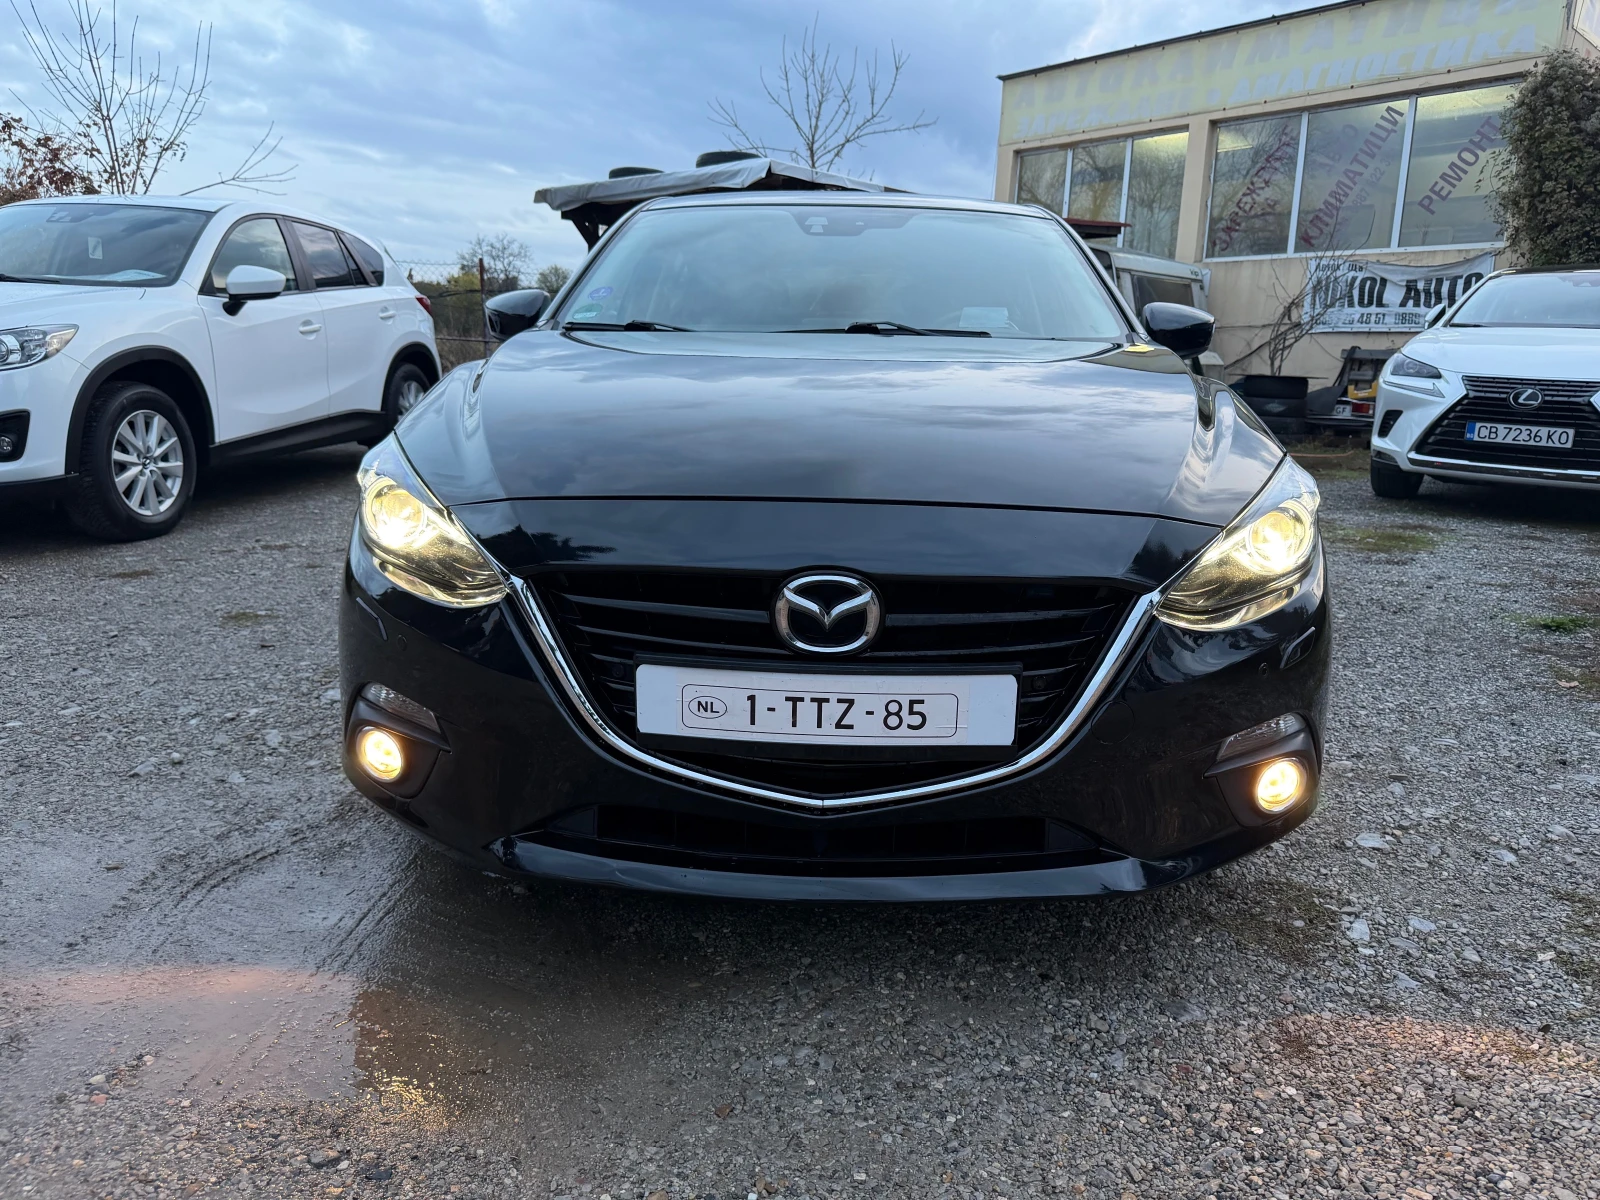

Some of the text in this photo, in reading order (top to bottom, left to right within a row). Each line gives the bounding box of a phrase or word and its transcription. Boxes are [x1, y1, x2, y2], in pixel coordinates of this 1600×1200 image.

[1228, 25, 1536, 103] ДИАГНОСТИКА
[1300, 105, 1405, 247] КЛИМАТИЦИ
[1417, 116, 1501, 215] РЕМОНТ
[1357, 312, 1371, 325] 48
[1477, 425, 1498, 440] CB
[1502, 427, 1543, 443] 7236
[1546, 429, 1570, 445] KO
[697, 694, 928, 731] NL 1-TTZ-85
